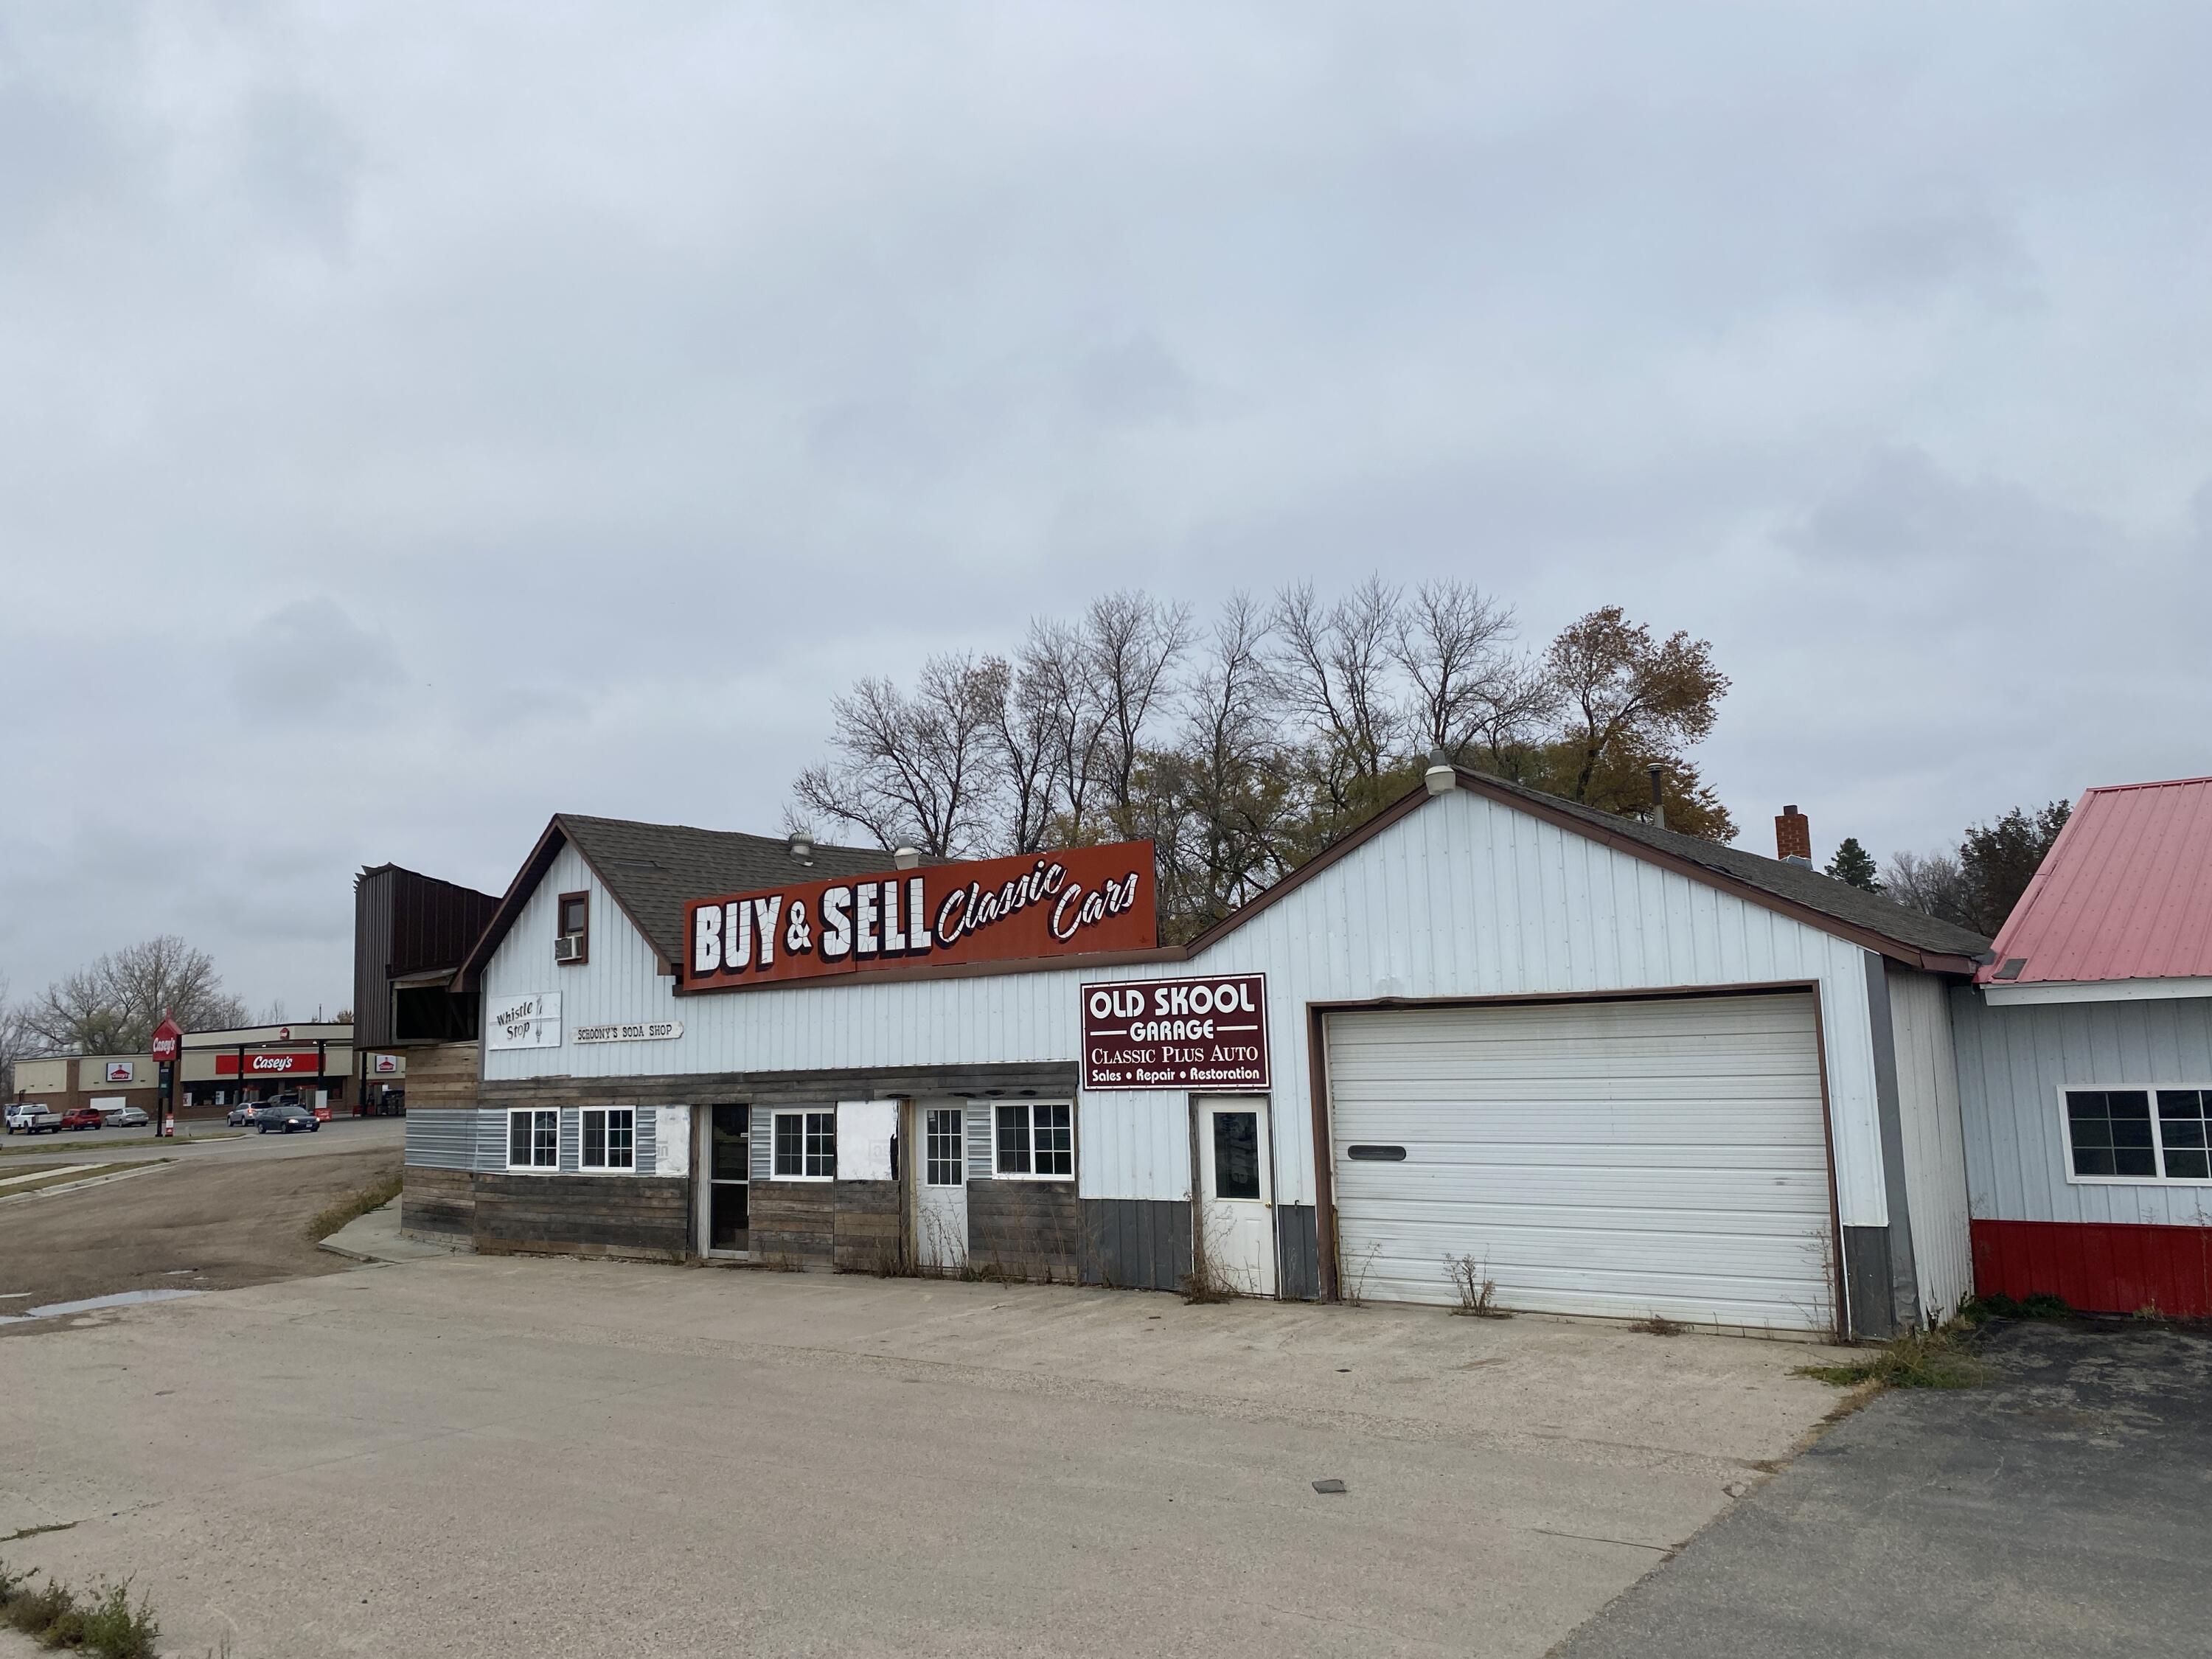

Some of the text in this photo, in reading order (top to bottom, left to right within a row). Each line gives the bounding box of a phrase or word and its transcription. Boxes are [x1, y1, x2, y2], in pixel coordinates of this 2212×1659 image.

[695, 860, 1139, 973] BUY & SELL Classic Cars
[1090, 984, 1255, 1018] OLD SKOOL
[496, 1001, 533, 1026] Whistle
[507, 1021, 530, 1040] Stop
[577, 1024, 672, 1040] SCHOONY'S SODA SHOP
[1130, 1019, 1214, 1042] GARAGE
[153, 1037, 175, 1054] Casey's
[253, 1055, 293, 1071] Casey's
[1092, 1066, 1259, 1084] Sales Repair Restoration
